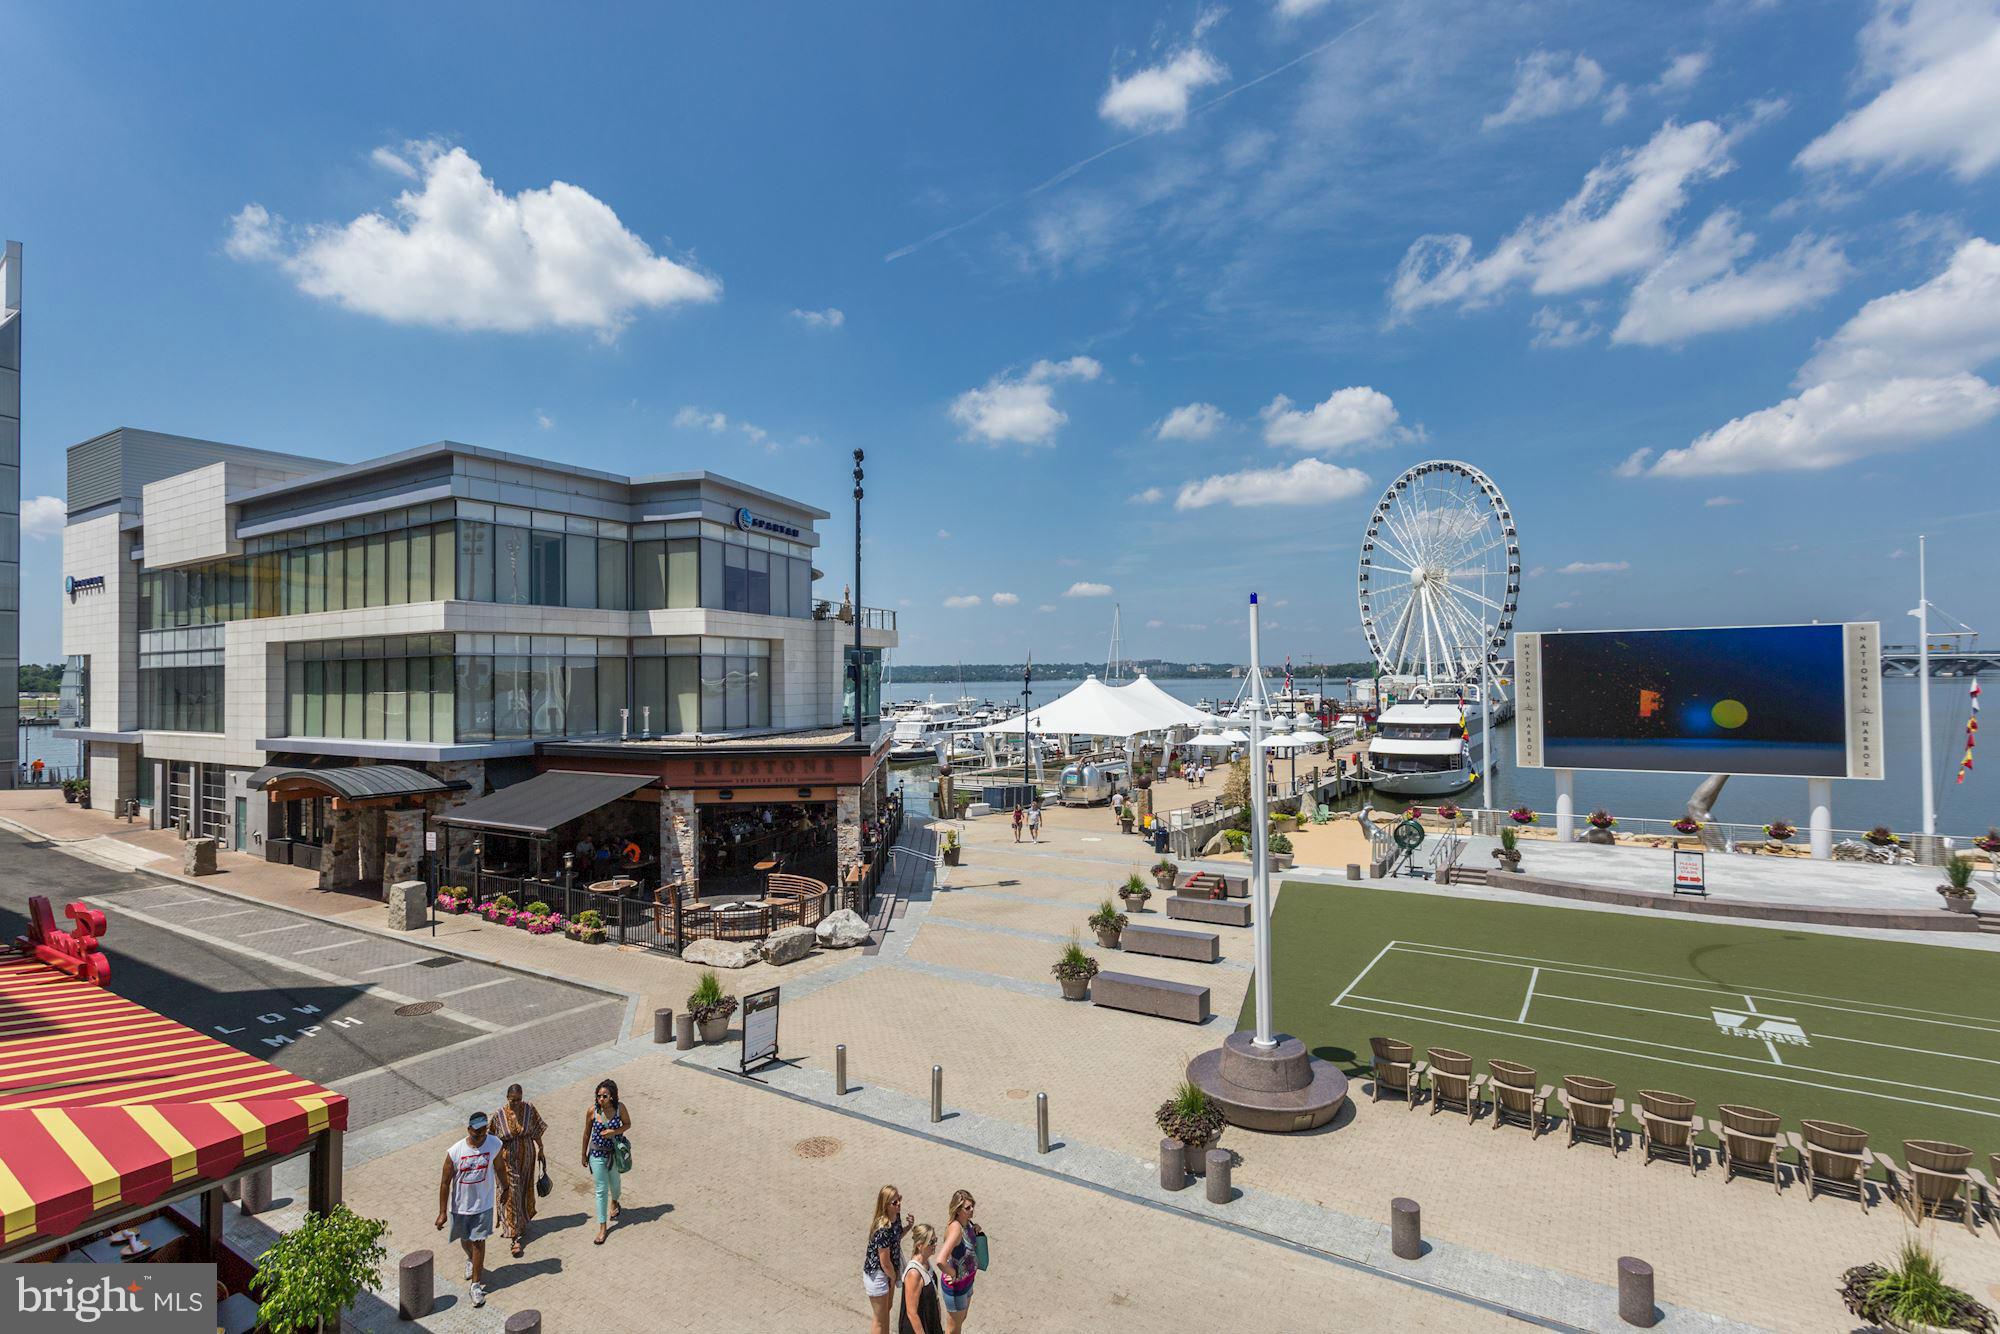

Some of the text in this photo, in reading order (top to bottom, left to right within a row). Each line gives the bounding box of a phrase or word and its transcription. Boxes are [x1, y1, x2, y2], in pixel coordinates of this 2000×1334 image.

[1859, 636, 1870, 767] NATIONAL HARBOR
[694, 759, 835, 776] REDSTONE
[261, 1017, 364, 1047] MPH
[1717, 1024, 1811, 1044] TENNIS
